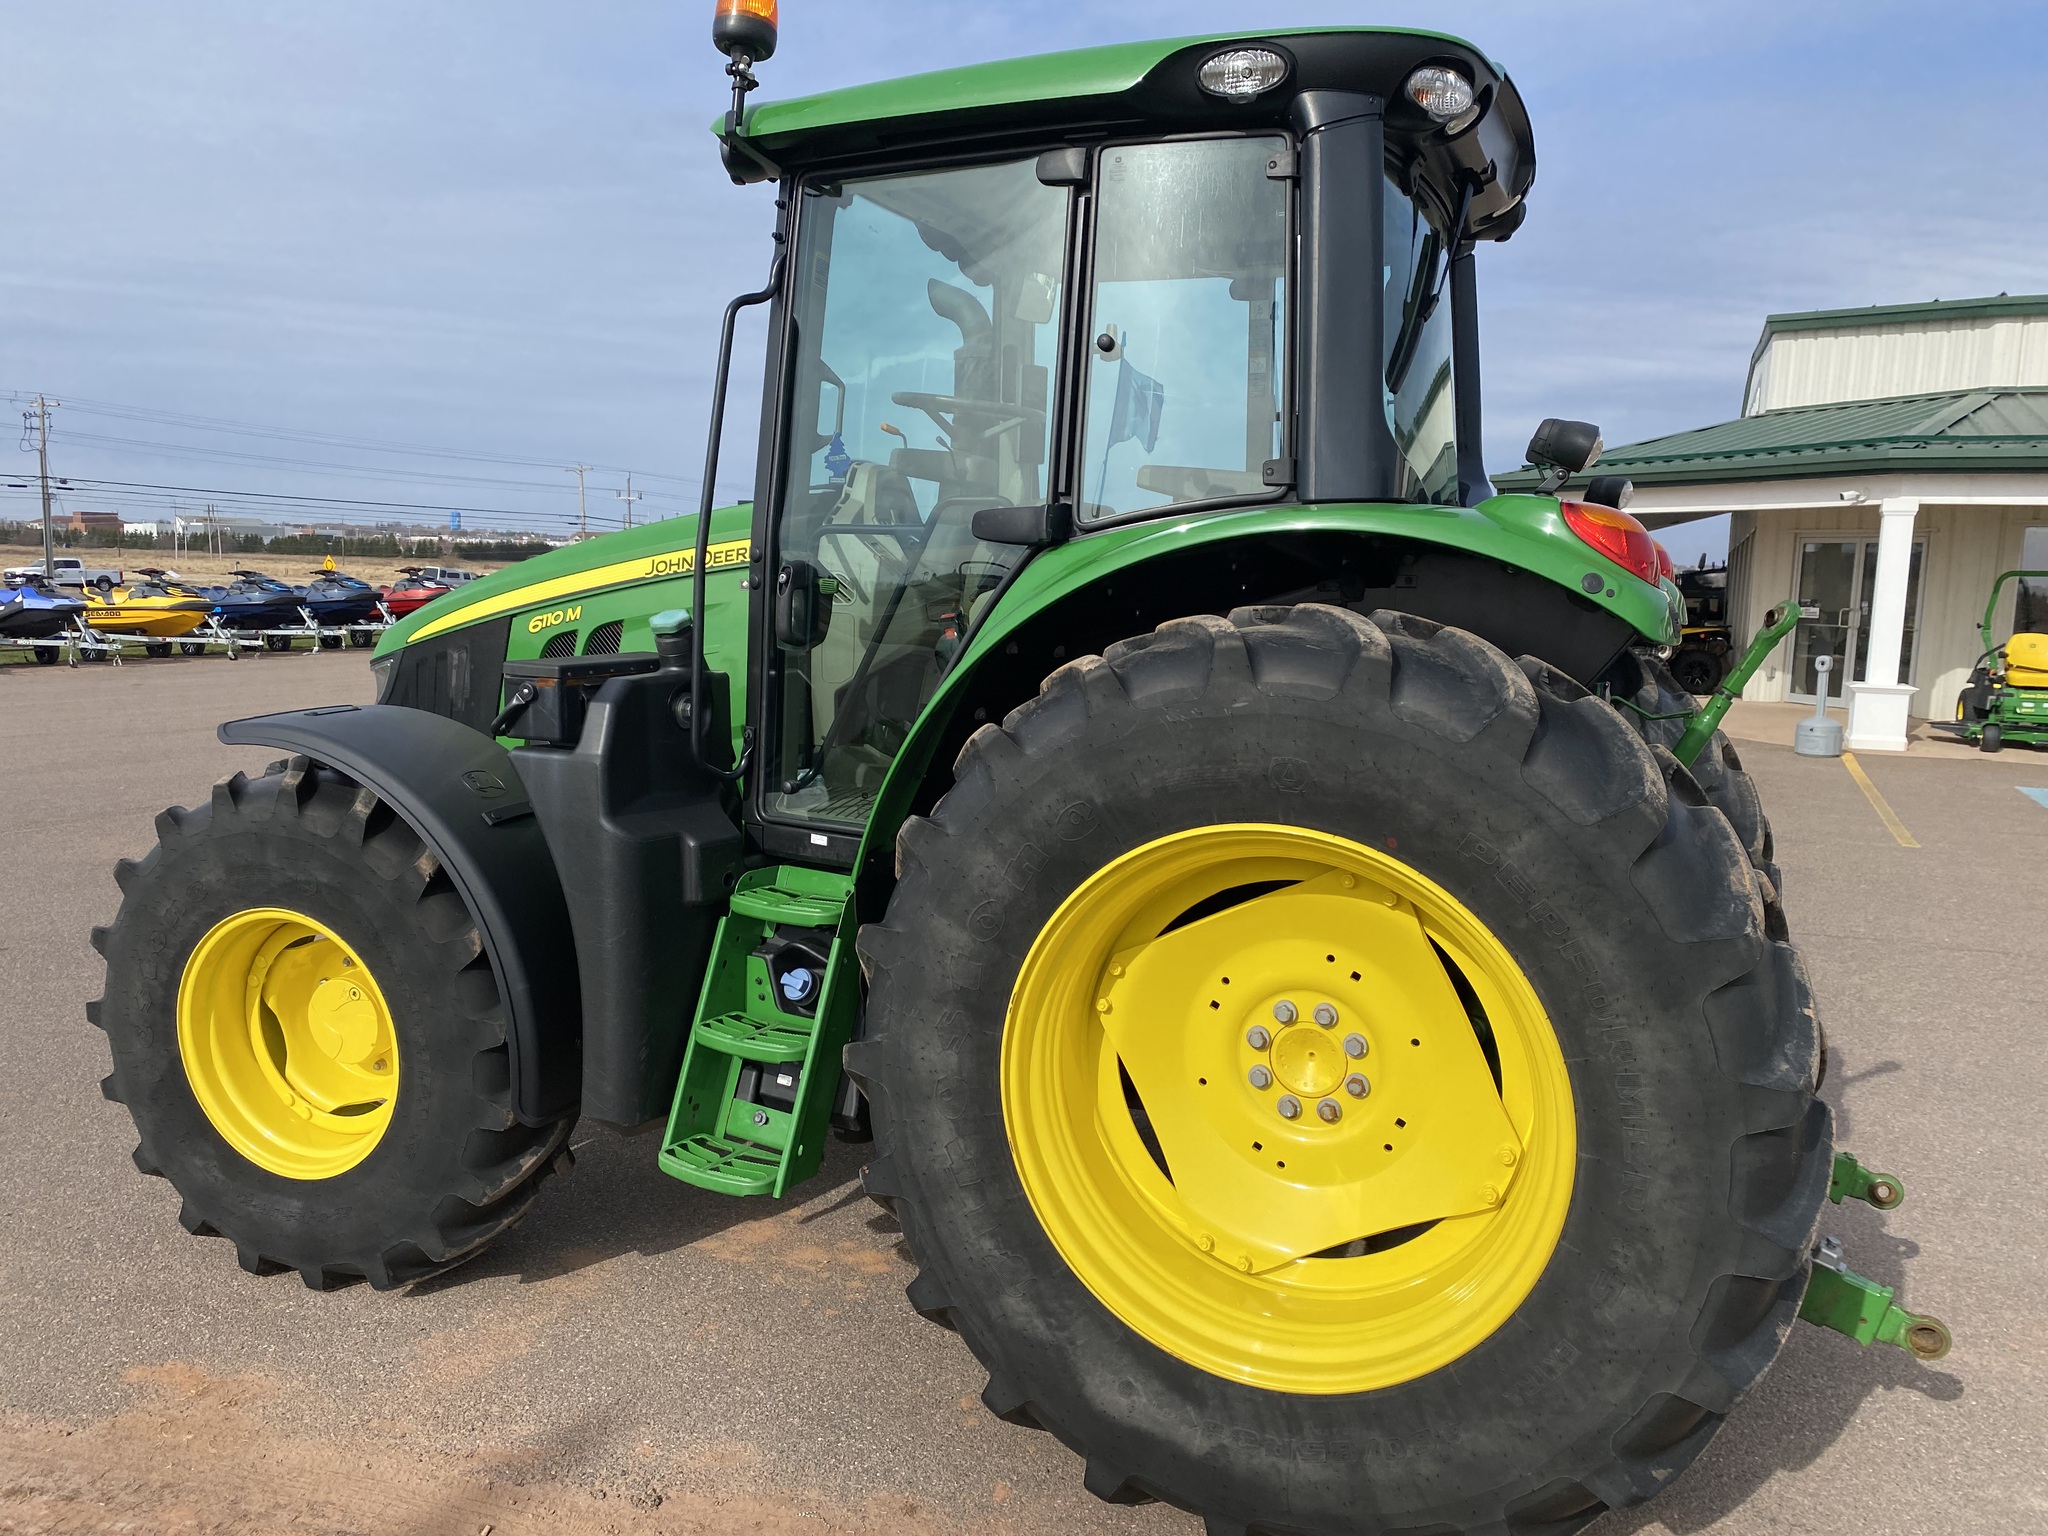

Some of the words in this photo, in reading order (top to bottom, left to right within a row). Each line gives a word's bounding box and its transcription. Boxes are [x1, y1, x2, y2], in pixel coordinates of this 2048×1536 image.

[645, 555, 694, 575] JOHN
[704, 546, 750, 566] DEER
[528, 610, 564, 633] 6110
[565, 605, 582, 622] M
[1456, 831, 1652, 1213] PERFORMER
